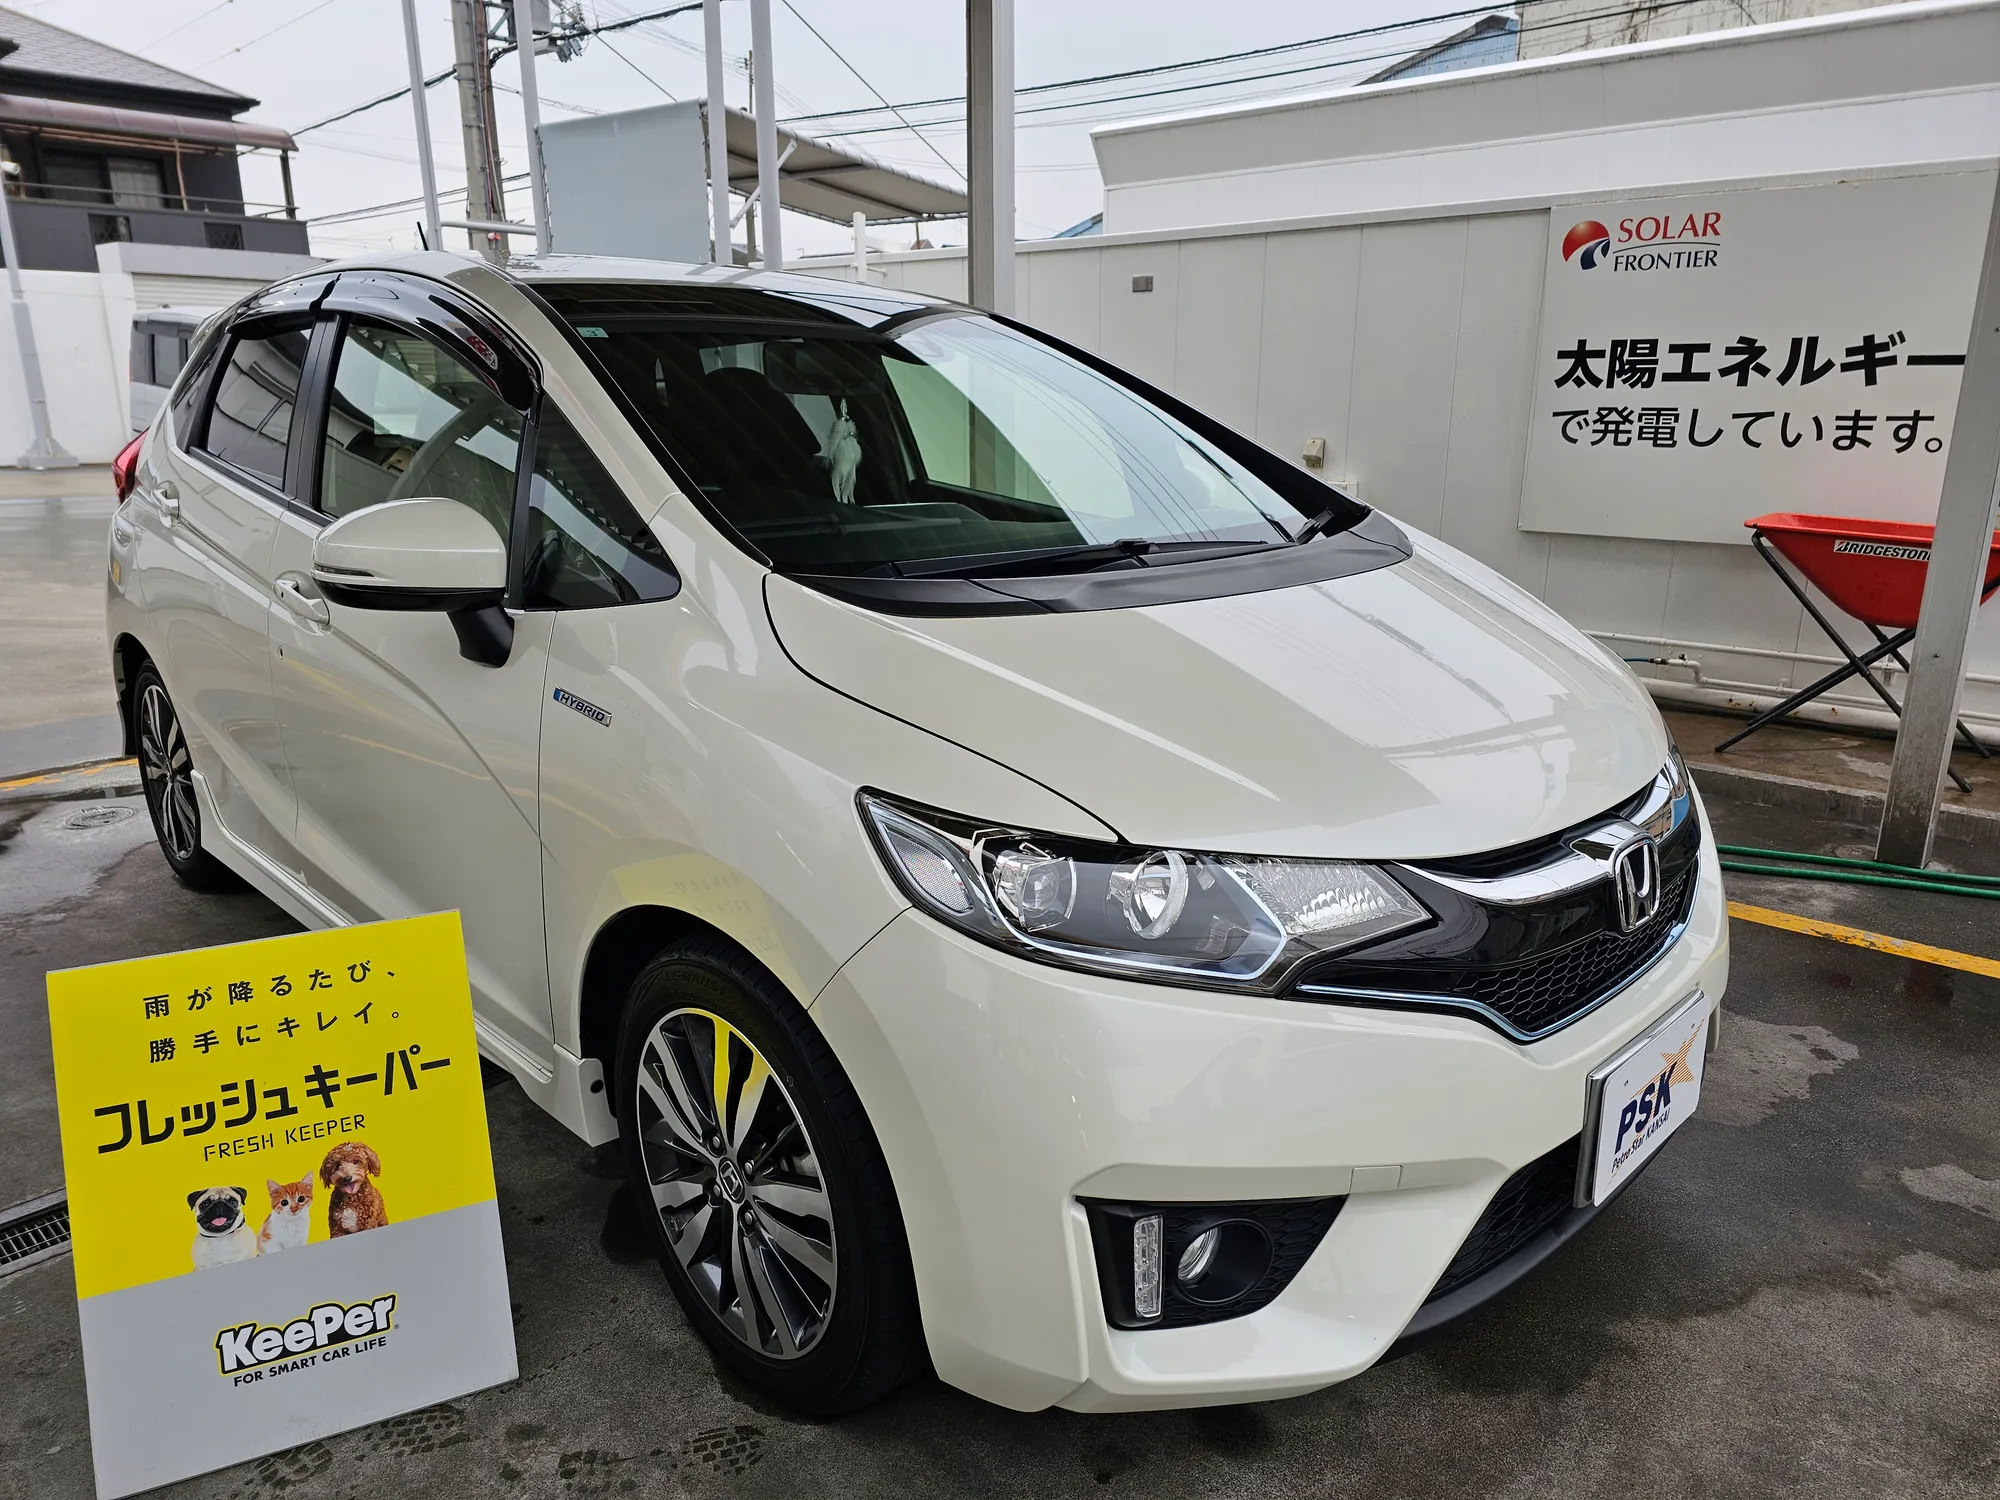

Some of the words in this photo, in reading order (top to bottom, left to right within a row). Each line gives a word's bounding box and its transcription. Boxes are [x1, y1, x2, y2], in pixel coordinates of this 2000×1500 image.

[1617, 211, 1722, 243] SOLAR
[1613, 249, 1718, 272] FRONTIER
[1554, 330, 1966, 389] 太陽エネルギー
[1552, 405, 1943, 454] で発電しています。
[1835, 540, 1932, 561] BRIDGESTON
[559, 692, 606, 722] HYBRID
[143, 959, 396, 1019] 雨が降るたび、
[149, 1001, 400, 1063] 勝手にキレイ。
[94, 1044, 451, 1154] フレッシュキーパー
[1614, 1060, 1678, 1155] PSK
[204, 1132, 274, 1162] FRESH
[285, 1113, 366, 1145] KEEPER
[216, 1294, 397, 1374] KeePer
[233, 1370, 264, 1387] FOR
[269, 1355, 318, 1378] SMART
[322, 1346, 351, 1363] CAR
[355, 1336, 387, 1354] LIFE
